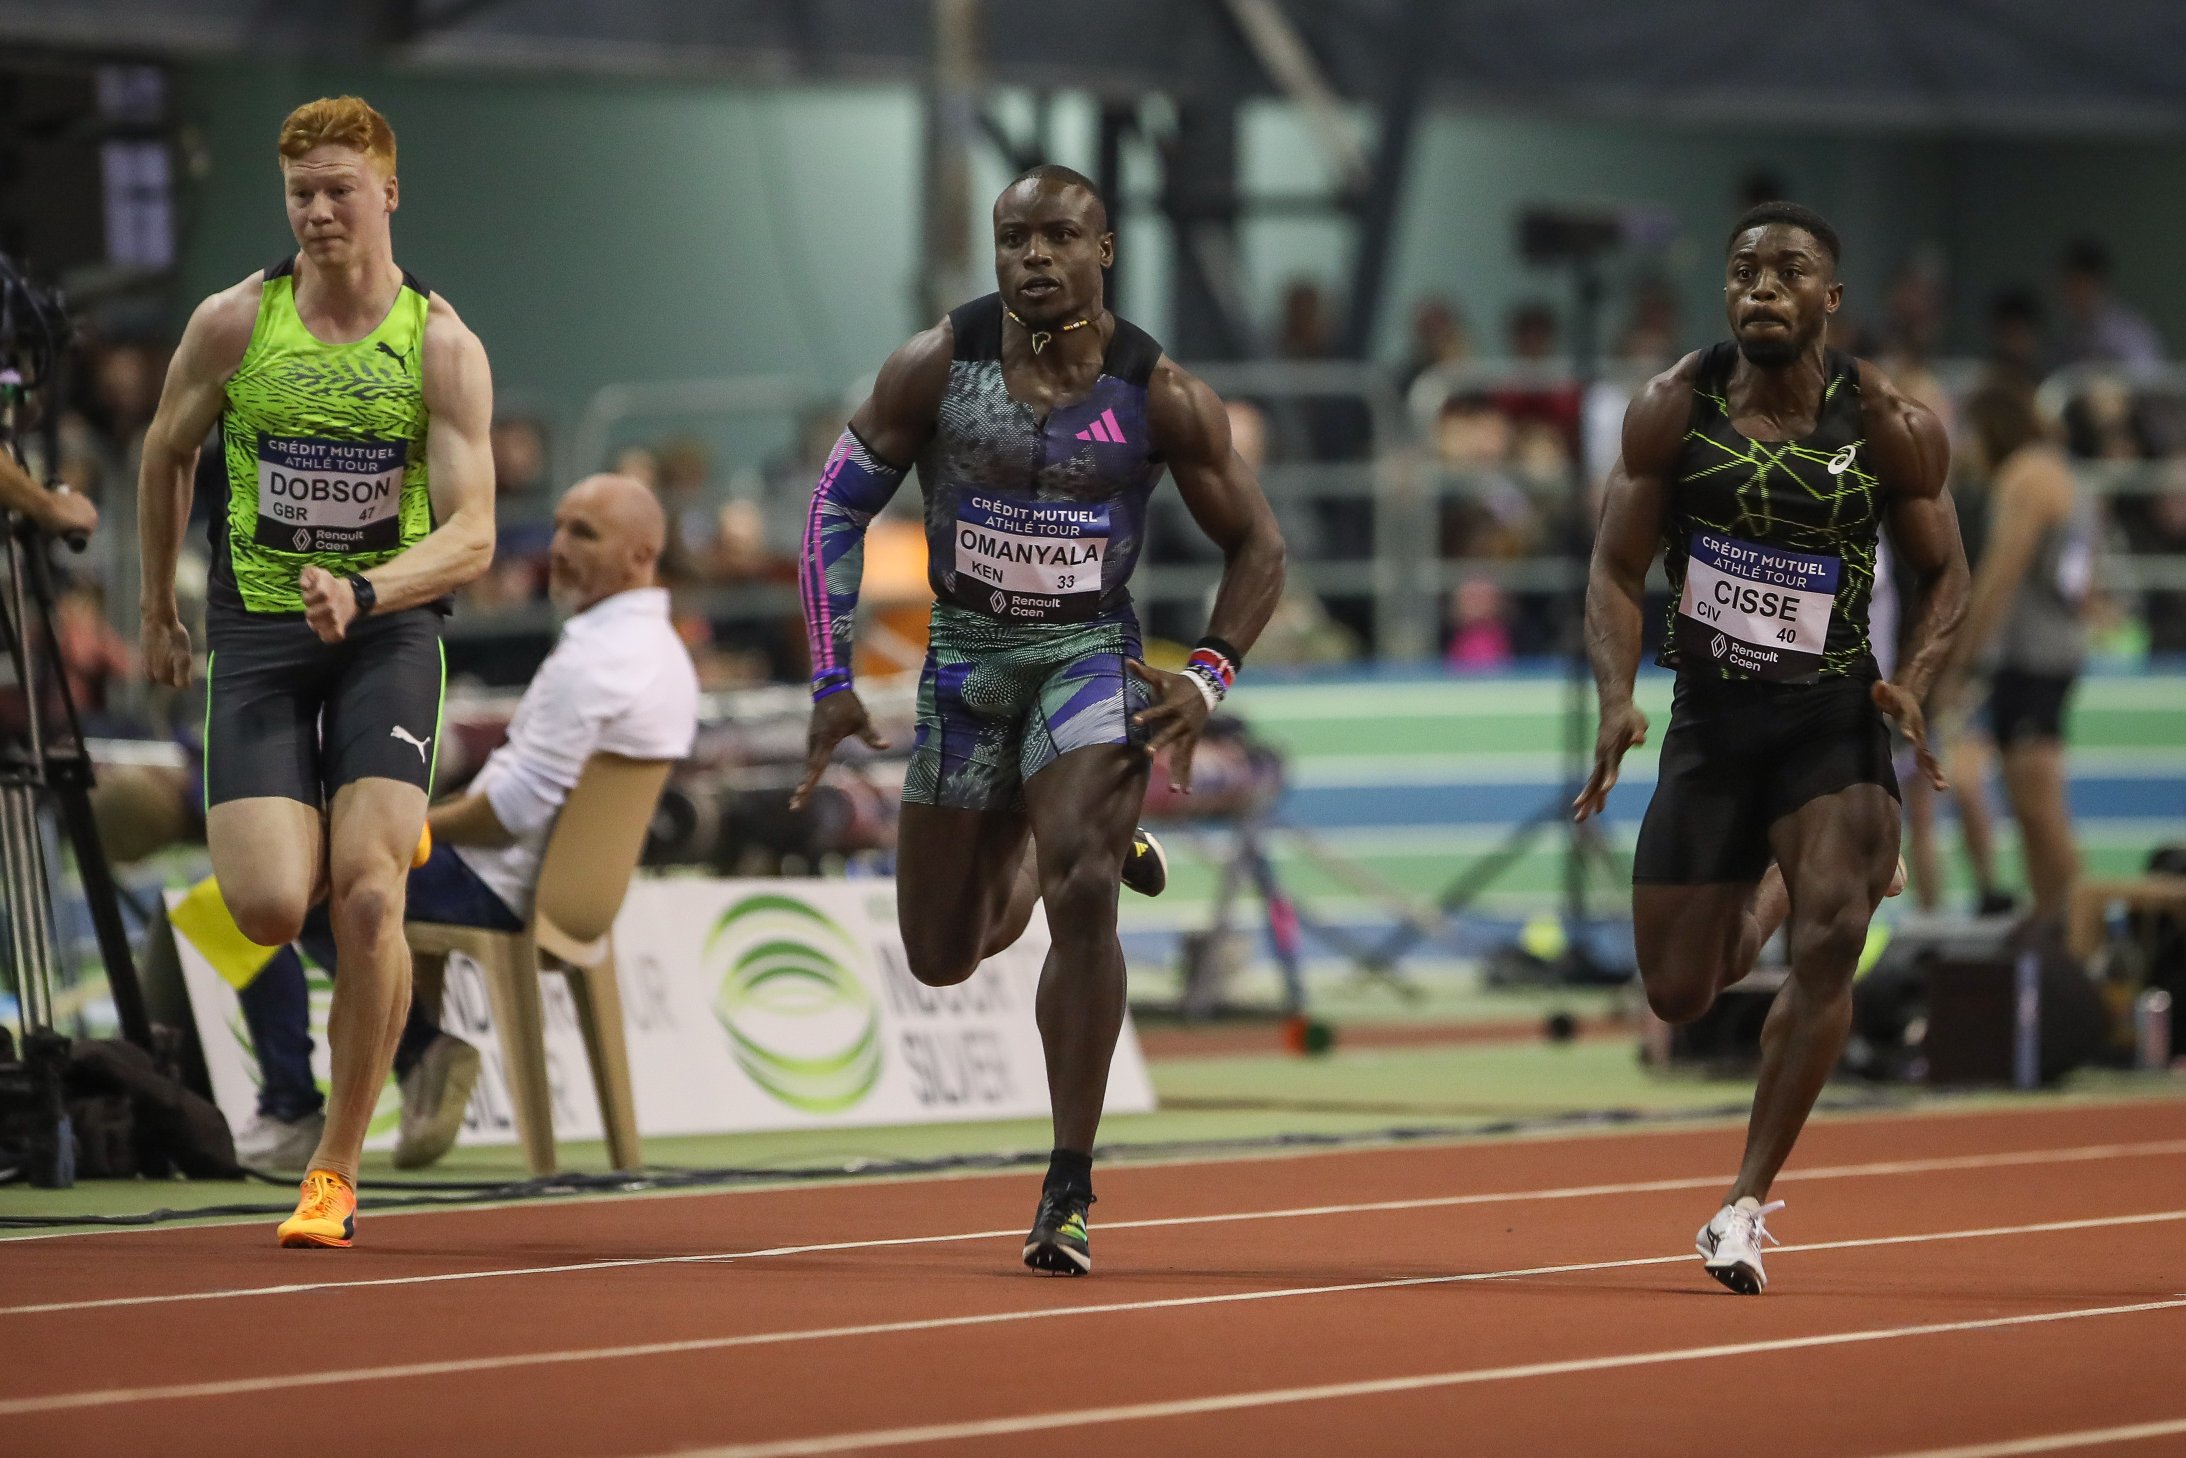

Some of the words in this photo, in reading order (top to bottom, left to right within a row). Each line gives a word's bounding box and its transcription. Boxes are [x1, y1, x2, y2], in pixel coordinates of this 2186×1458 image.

[268, 437, 326, 455] CRÉDIT
[331, 446, 396, 460] MUTUEL
[285, 454, 333, 468] ATHLÉ
[336, 460, 378, 472] TOUR
[270, 471, 391, 504] DOBSON
[273, 502, 308, 521] GBR
[359, 507, 375, 521] 47
[971, 497, 1029, 519] CRÉDIT
[1033, 510, 1098, 523] MUTUEL
[316, 530, 365, 541] Renault
[985, 516, 1034, 534] ATHLÉ
[1038, 524, 1080, 536] TOUR
[315, 540, 350, 551] Caen
[960, 529, 1099, 566] OMANYALA
[1702, 535, 1759, 563] CRÉDIT
[1761, 554, 1827, 577] MUTUEL
[972, 560, 1003, 584] KEN
[1057, 575, 1075, 589] 33
[1713, 557, 1762, 579] ATHLÉ
[1765, 570, 1808, 588] TOUR
[1012, 595, 1061, 608] Renault
[1697, 601, 1721, 622] CIV
[1714, 580, 1801, 622] CISSE
[1010, 607, 1045, 618] Caen
[1776, 627, 1797, 644] 40
[1729, 652, 1761, 672] Caen
[1731, 642, 1779, 663] Renault
